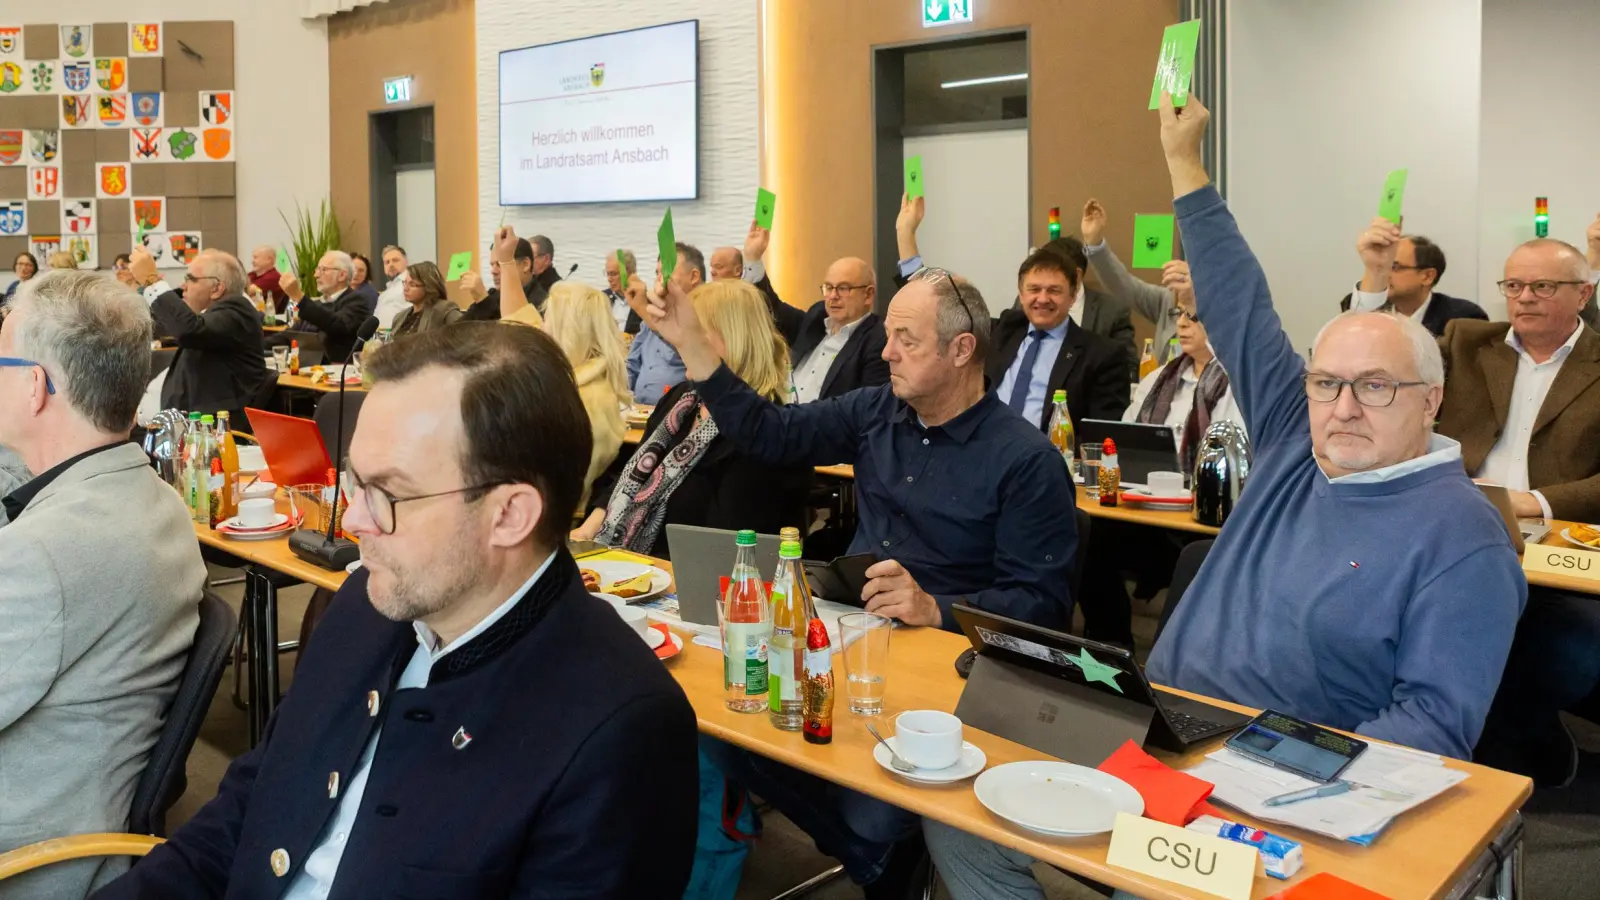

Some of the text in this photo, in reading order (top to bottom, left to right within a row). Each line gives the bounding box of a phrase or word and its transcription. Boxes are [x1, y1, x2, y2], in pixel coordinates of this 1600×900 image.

[532, 123, 655, 147] Herzlich willkommen
[520, 145, 670, 170] im Landratsamt Ansbach
[1546, 553, 1592, 571] CSU
[1147, 836, 1217, 876] CSU
